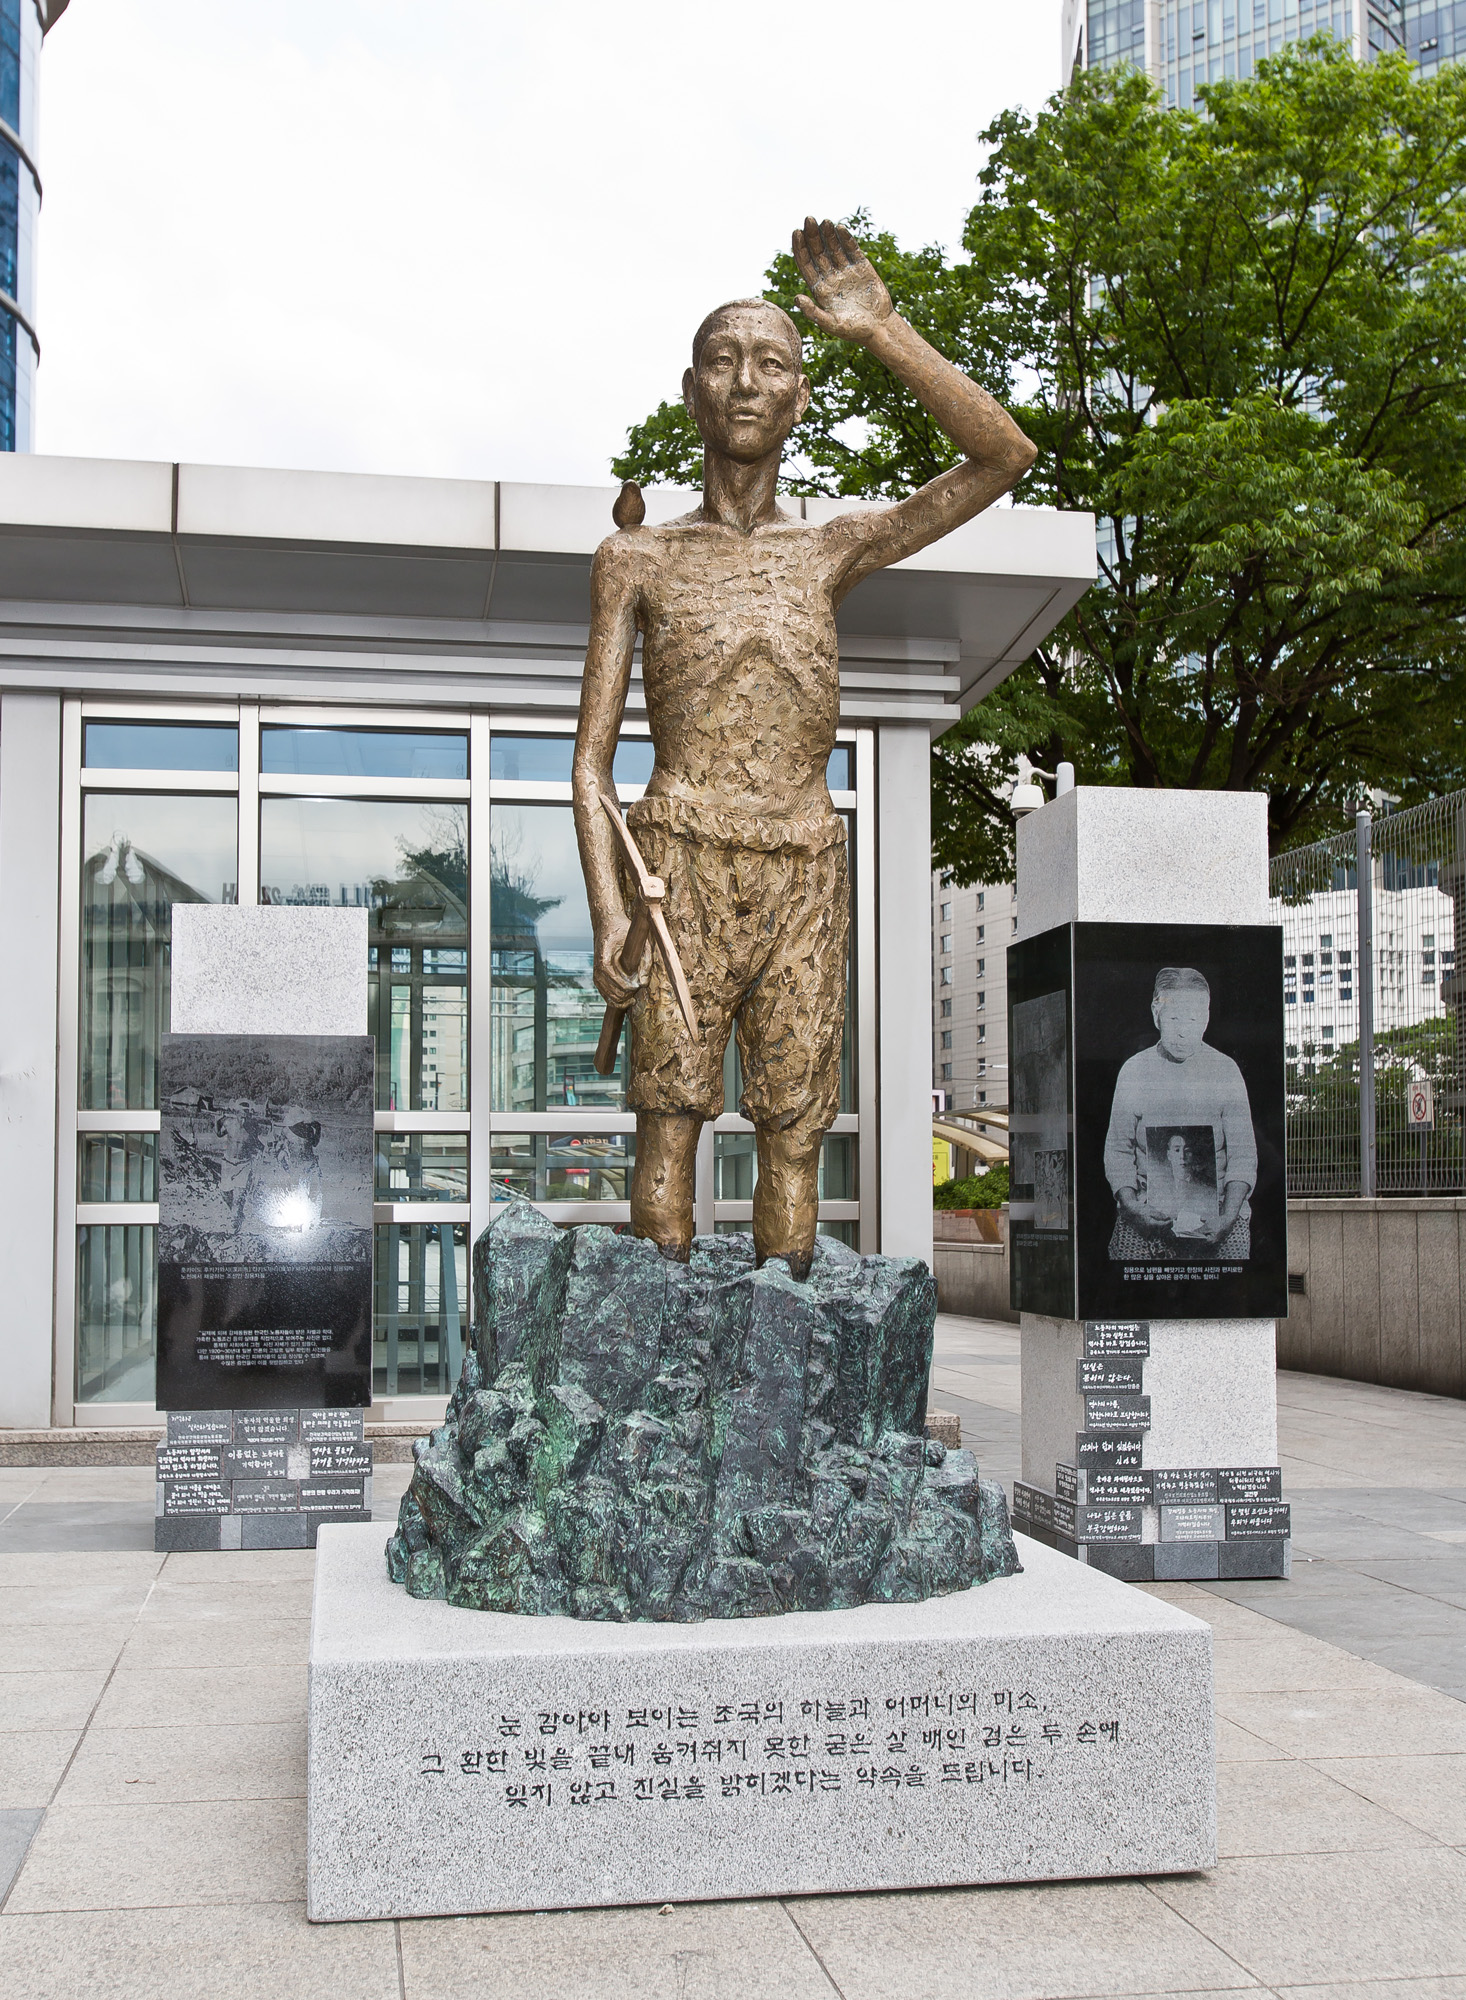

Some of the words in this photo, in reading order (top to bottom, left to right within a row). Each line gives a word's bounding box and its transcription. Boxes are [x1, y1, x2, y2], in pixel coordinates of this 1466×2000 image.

[1083, 1362, 1103, 1372] 진실은
[228, 1450, 258, 1460] 이름없는
[499, 1713, 521, 1737] 눈
[538, 1709, 611, 1734] 감아야
[626, 1706, 698, 1731] 보이는
[714, 1701, 783, 1725] 조국의
[801, 1697, 868, 1722] 하늘과
[885, 1692, 976, 1719] 어머니의
[421, 1754, 445, 1775] 그
[460, 1750, 508, 1774] 환한
[525, 1748, 573, 1772] 빛을
[589, 1743, 635, 1770] 끝내
[652, 1737, 747, 1766] 움켜쥐지
[763, 1733, 810, 1760] 못한
[825, 1731, 872, 1756] 굳은
[886, 1729, 907, 1753] 살
[923, 1727, 967, 1751] 배인
[983, 1724, 1027, 1748] 검은
[1042, 1722, 1062, 1745] 두
[1077, 1720, 1120, 1745] 손에
[506, 1783, 552, 1808] 잊지
[571, 1780, 617, 1805] 않고
[634, 1775, 706, 1801] 진실을
[720, 1766, 843, 1798] 밝히겠다는
[857, 1763, 927, 1790] 약속을
[941, 1757, 1044, 1785] 드립니다.
